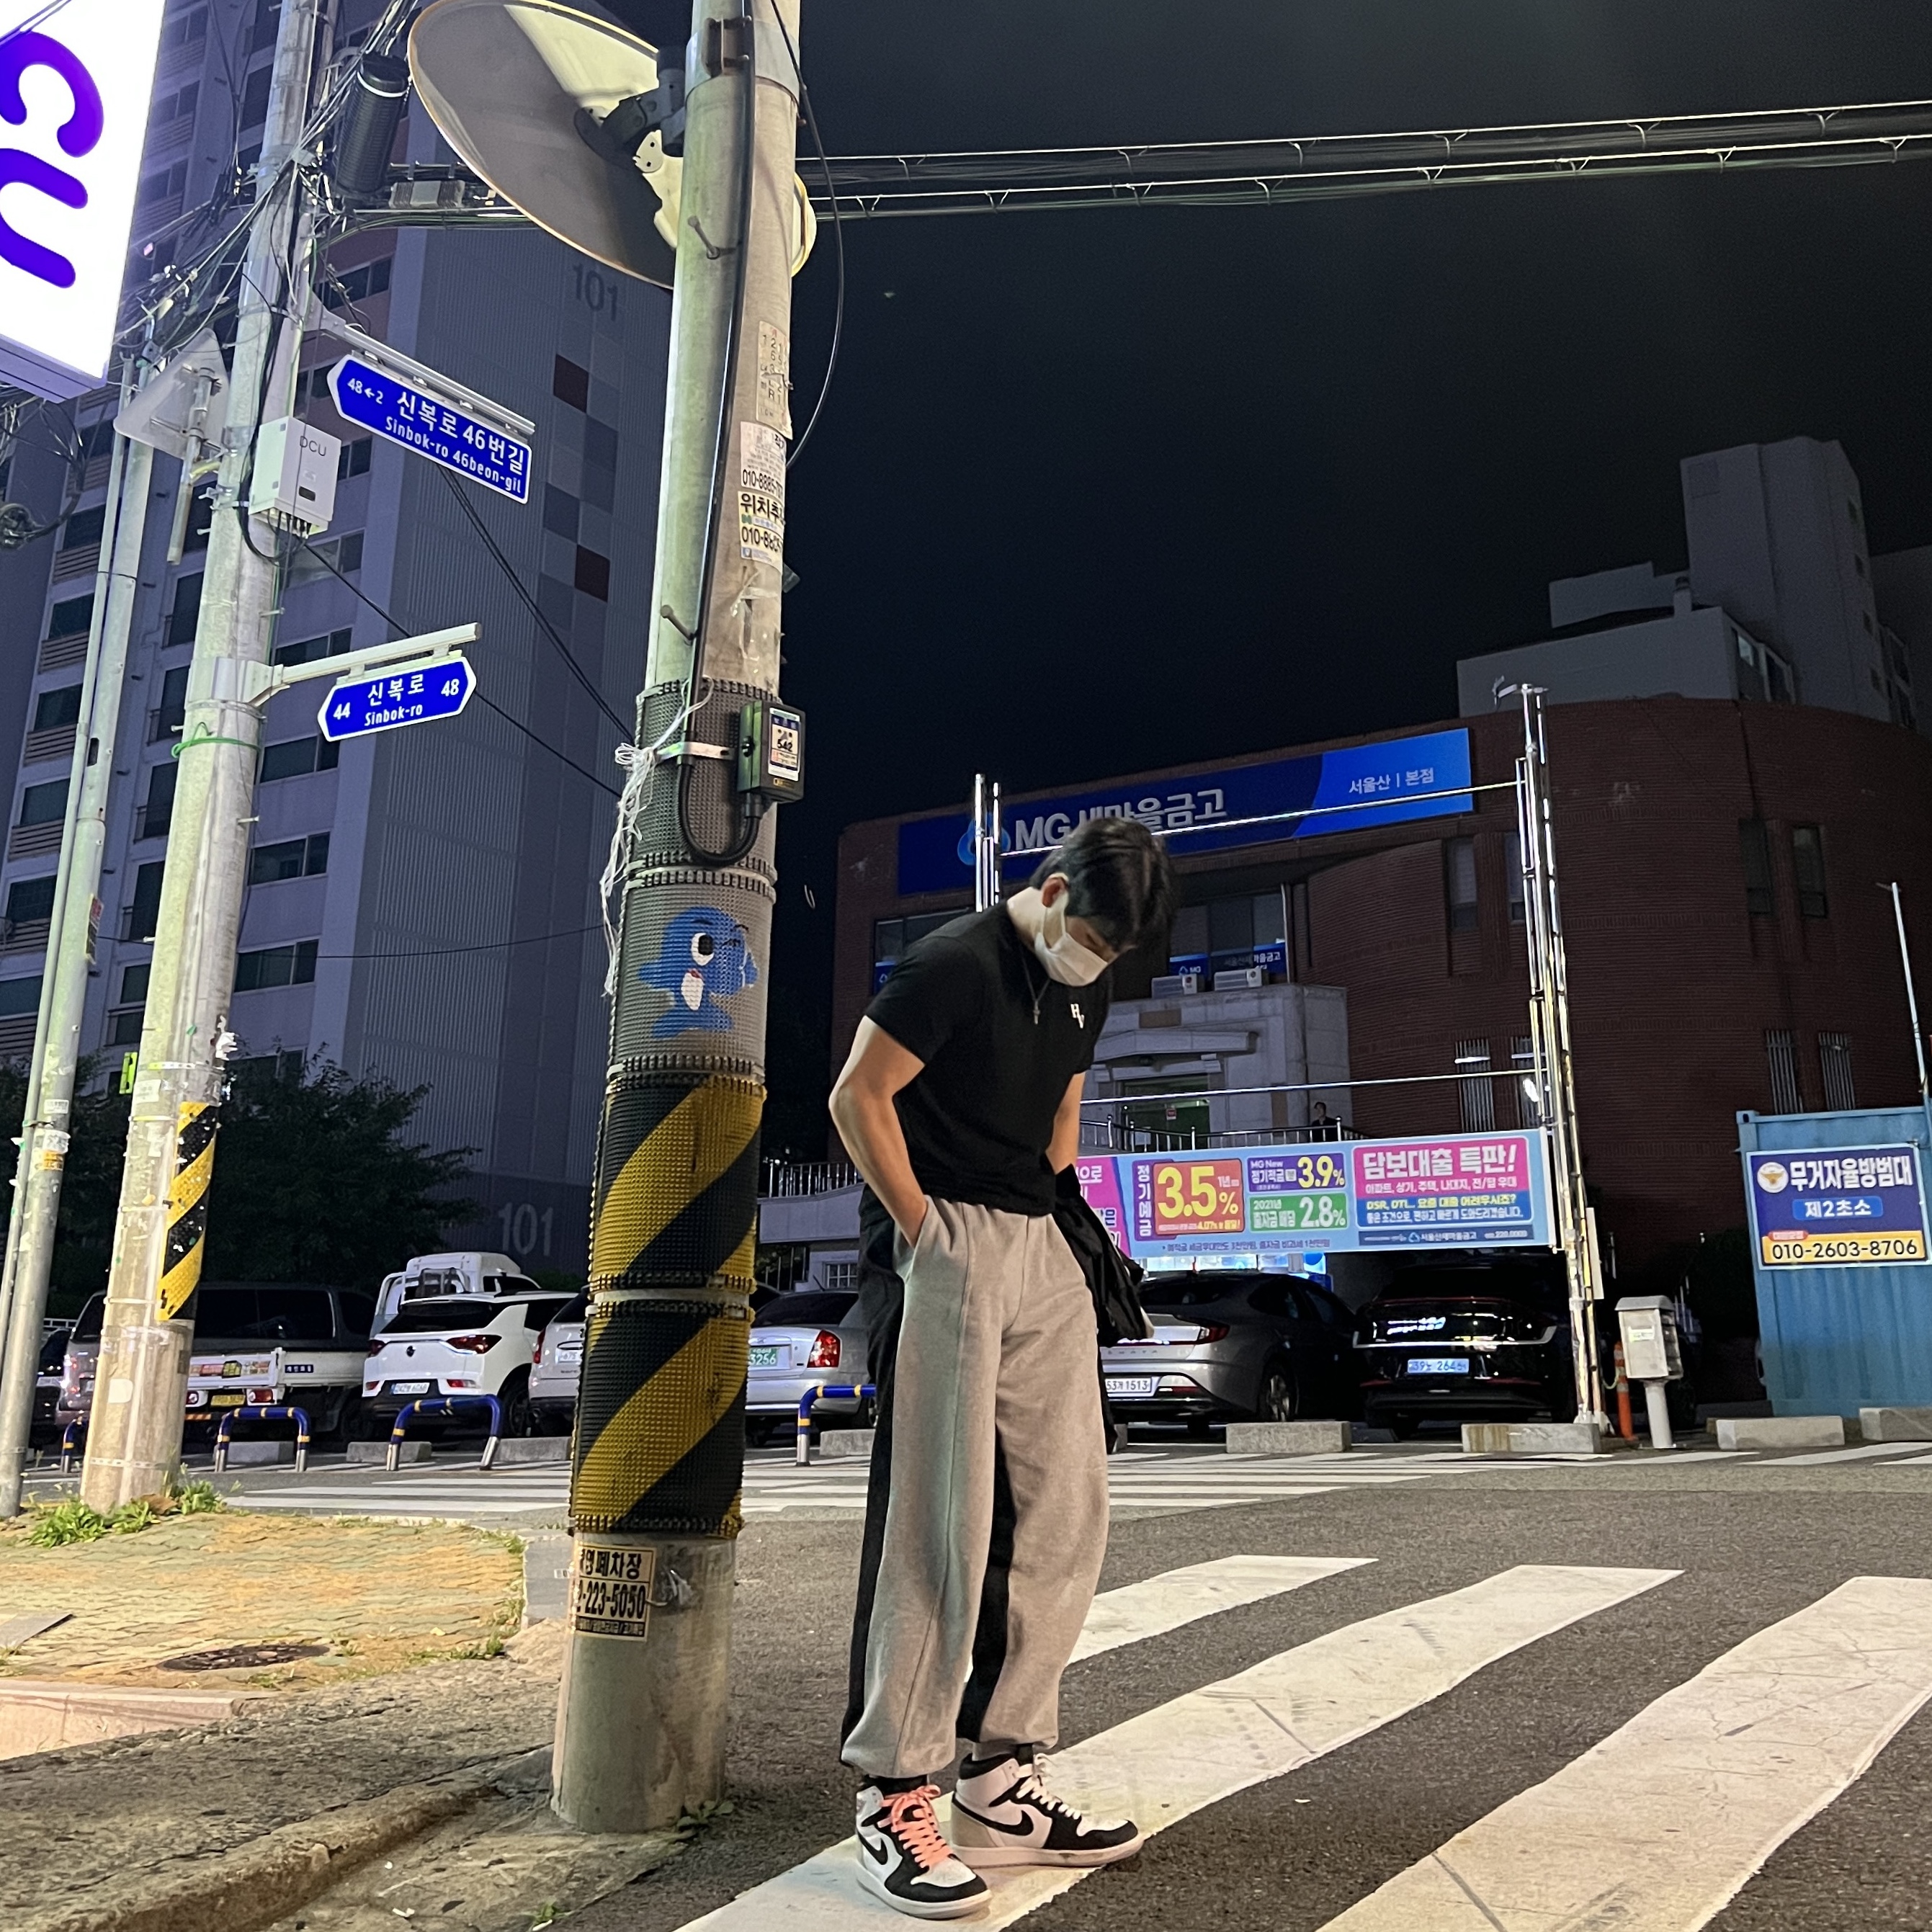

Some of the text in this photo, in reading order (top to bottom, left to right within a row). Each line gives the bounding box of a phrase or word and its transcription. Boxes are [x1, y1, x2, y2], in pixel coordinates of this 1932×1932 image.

[0, 31, 104, 288] CU
[573, 263, 618, 321] 101
[300, 436, 326, 456] DCU
[385, 416, 521, 493] Sinbok-ro 46beon-gil
[333, 674, 460, 720] 44 신복로 48
[365, 705, 423, 726] Sinbok-ro
[1349, 767, 1434, 795] 서울산 본점
[1016, 813, 1071, 851] MG
[1297, 1155, 1346, 1188] 3.9%
[1363, 1145, 1517, 1181] 담보대출 특판!
[1790, 1155, 1913, 1191] 무거자율방범대
[1137, 1165, 1153, 1237] 정기예금
[1300, 1196, 1346, 1228] 2.8%
[1804, 1199, 1871, 1218] 제2초소
[498, 1202, 554, 1256] 101
[1772, 1240, 1918, 1260] 010-2603-8706
[748, 1353, 777, 1366] 3256
